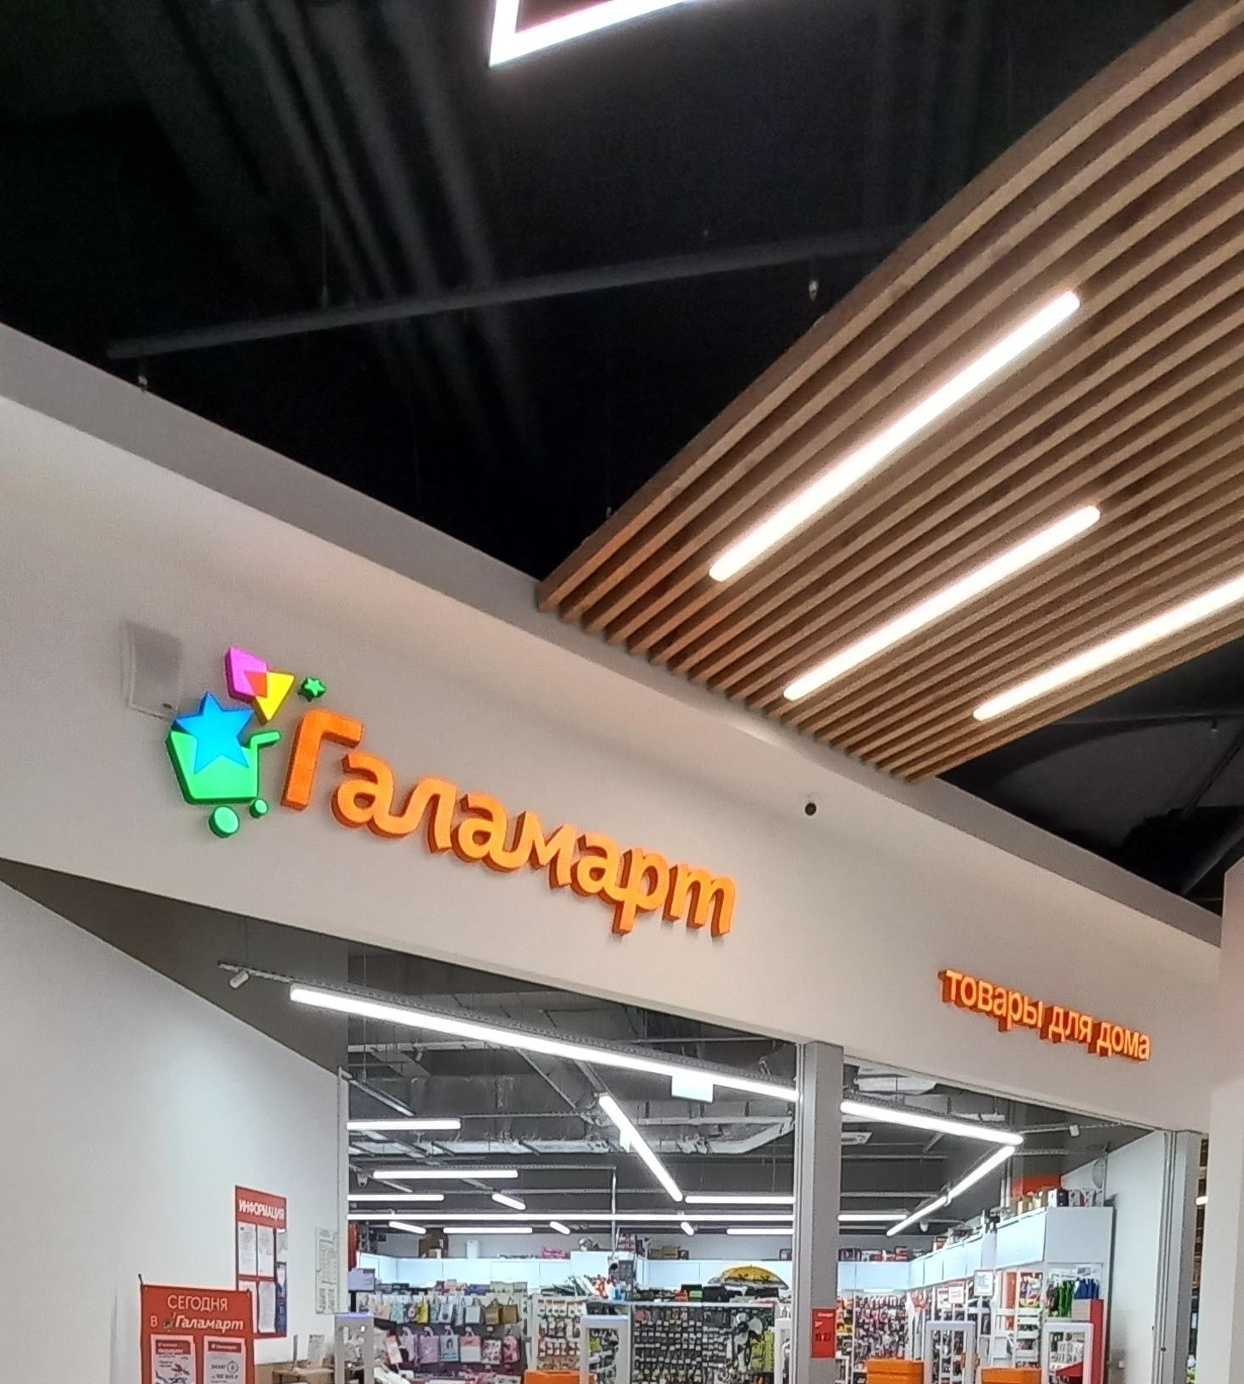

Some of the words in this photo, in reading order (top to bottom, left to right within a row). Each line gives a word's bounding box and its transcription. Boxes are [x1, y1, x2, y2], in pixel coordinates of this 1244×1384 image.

[282, 708, 738, 936] Галамарт
[941, 969, 1044, 1031] товары
[1046, 1006, 1093, 1042] для
[1094, 1022, 1151, 1060] дома
[239, 1198, 285, 1220] ИНФОРМАЦИЯ
[167, 1294, 228, 1312] СЕГОДНЯ
[175, 1314, 244, 1334] Галамарт
